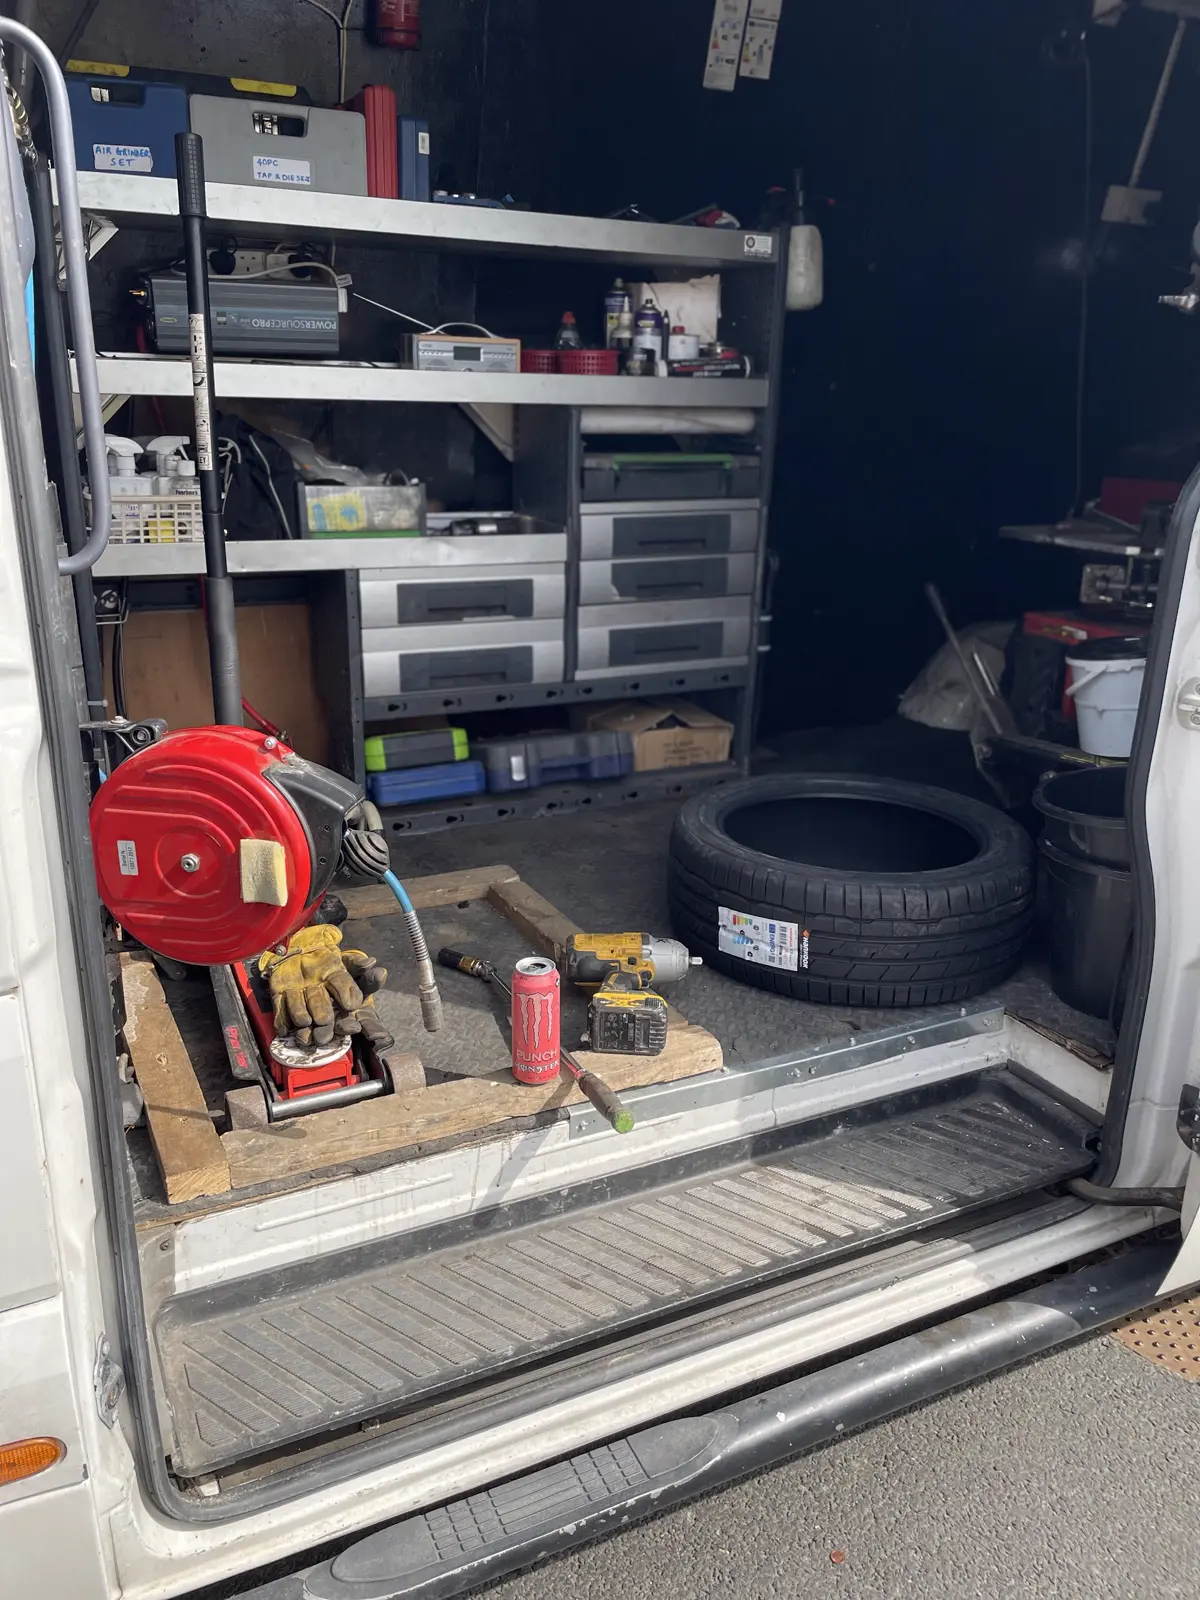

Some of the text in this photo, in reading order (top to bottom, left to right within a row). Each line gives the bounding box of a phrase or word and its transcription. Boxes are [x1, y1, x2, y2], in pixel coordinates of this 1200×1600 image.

[95, 145, 149, 158] AIR GRINDER
[110, 158, 135, 167] SET
[256, 158, 279, 167] 40PC
[257, 171, 272, 179] TAP
[251, 317, 337, 331] POWERSOURCEPRO
[515, 1047, 557, 1063] PUNCH
[514, 1059, 560, 1074] MONSTER
